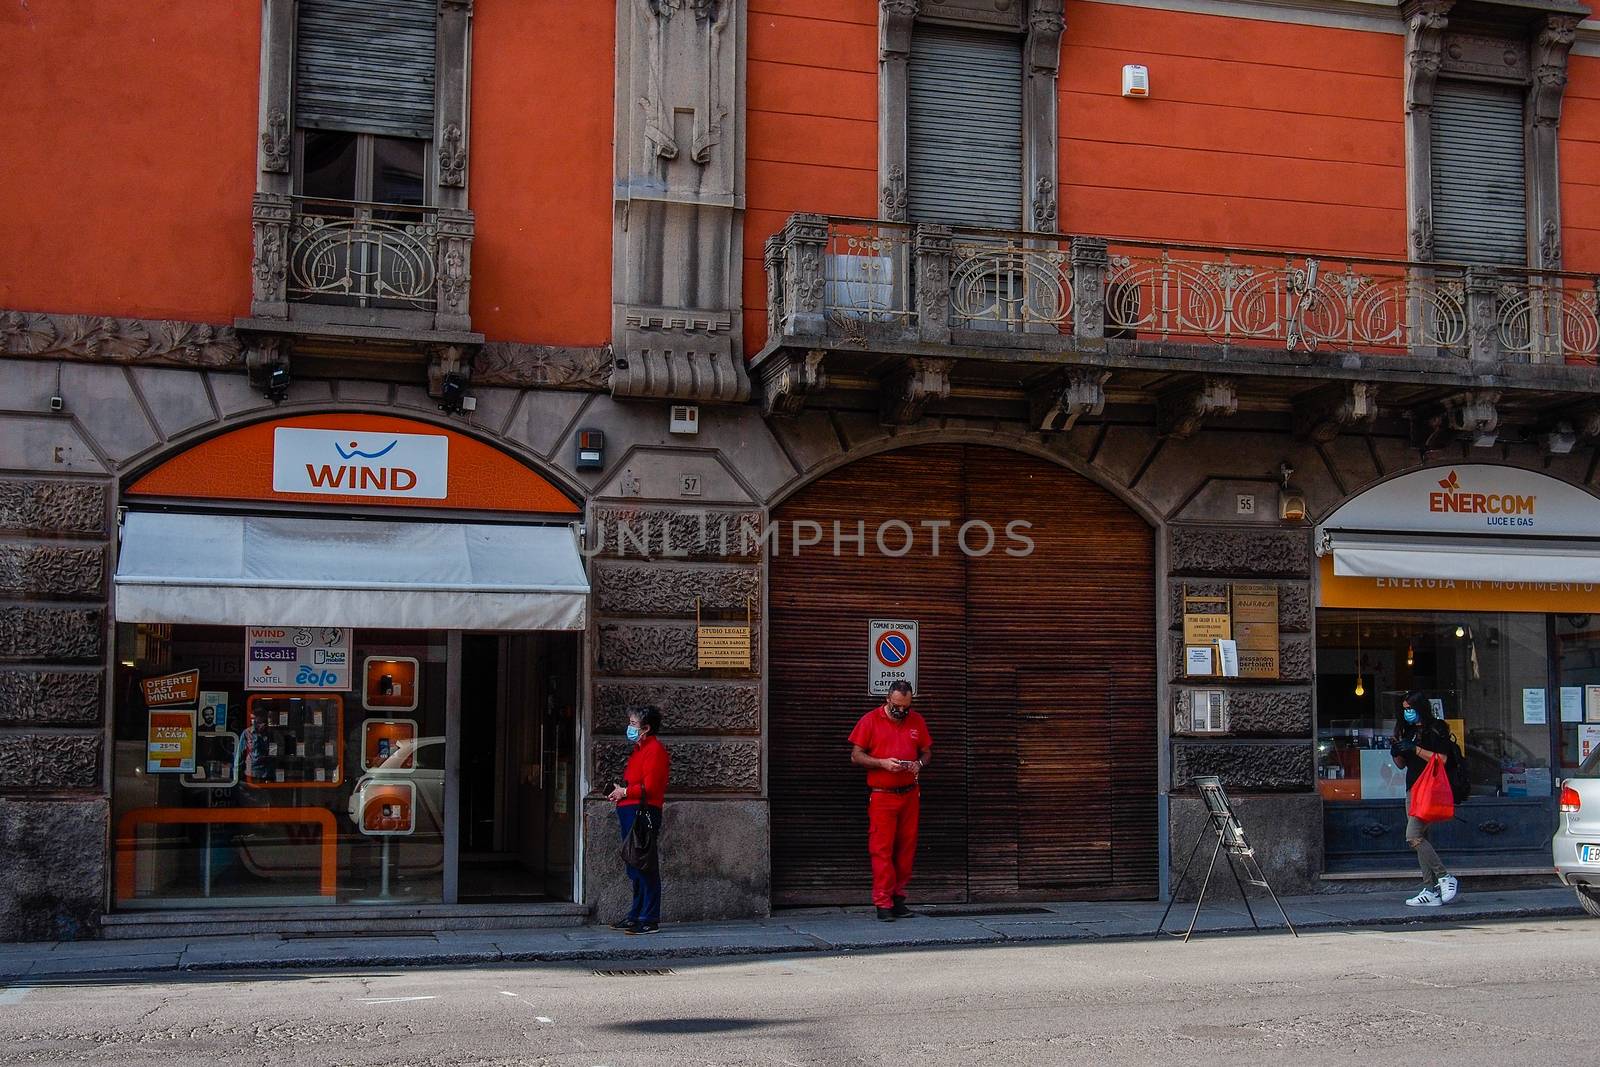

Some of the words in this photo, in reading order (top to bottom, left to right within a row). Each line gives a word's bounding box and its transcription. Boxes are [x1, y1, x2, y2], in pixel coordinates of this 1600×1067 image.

[306, 464, 417, 491] WIND
[684, 479, 697, 490] 57
[1240, 499, 1251, 510] 55
[1429, 492, 1535, 515] ENERCOM
[1487, 517, 1508, 526] LUCE
[1510, 517, 1515, 526] E
[1517, 518, 1533, 527] GAS
[251, 630, 285, 638] WIND
[146, 675, 193, 688] OFFERTE
[147, 686, 173, 694] LAST
[149, 690, 188, 701] MINUTE
